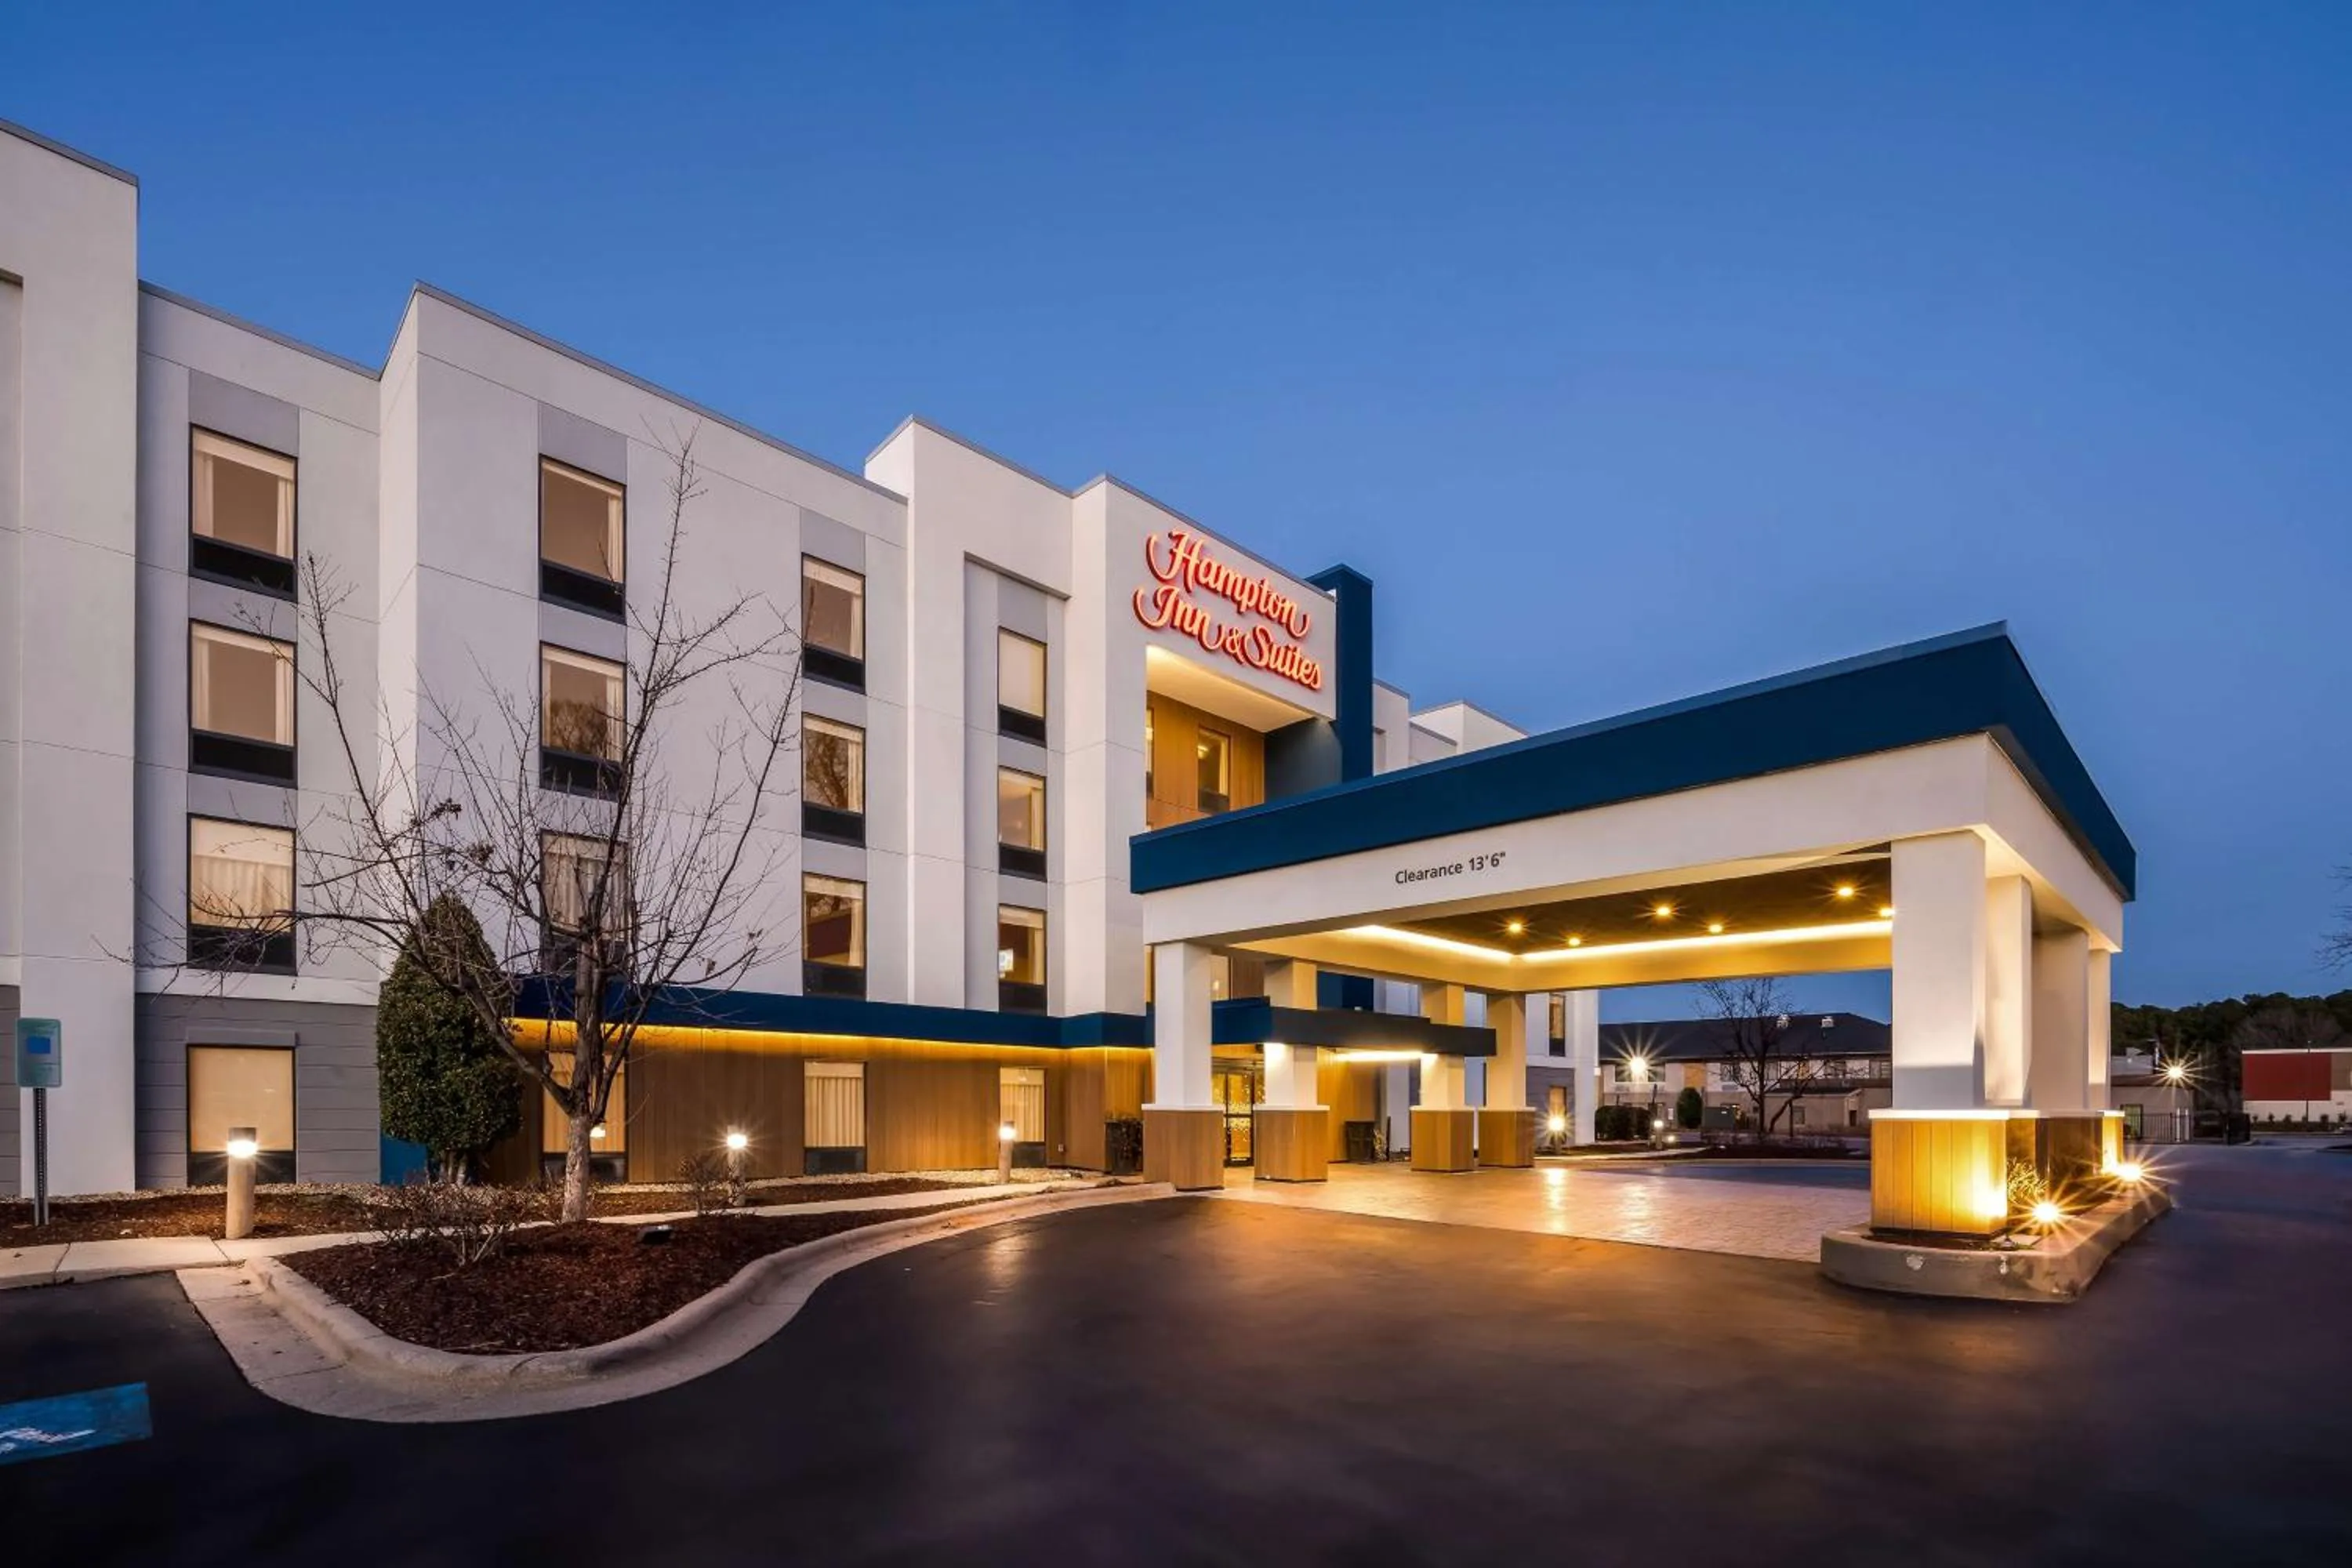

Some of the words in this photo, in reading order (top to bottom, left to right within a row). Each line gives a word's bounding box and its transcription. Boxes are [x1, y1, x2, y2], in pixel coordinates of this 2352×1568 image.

[1146, 528, 1311, 639] Hampton
[1132, 584, 1225, 652] Inn
[1241, 623, 1322, 691] Suites
[1395, 862, 1464, 884] Clearance
